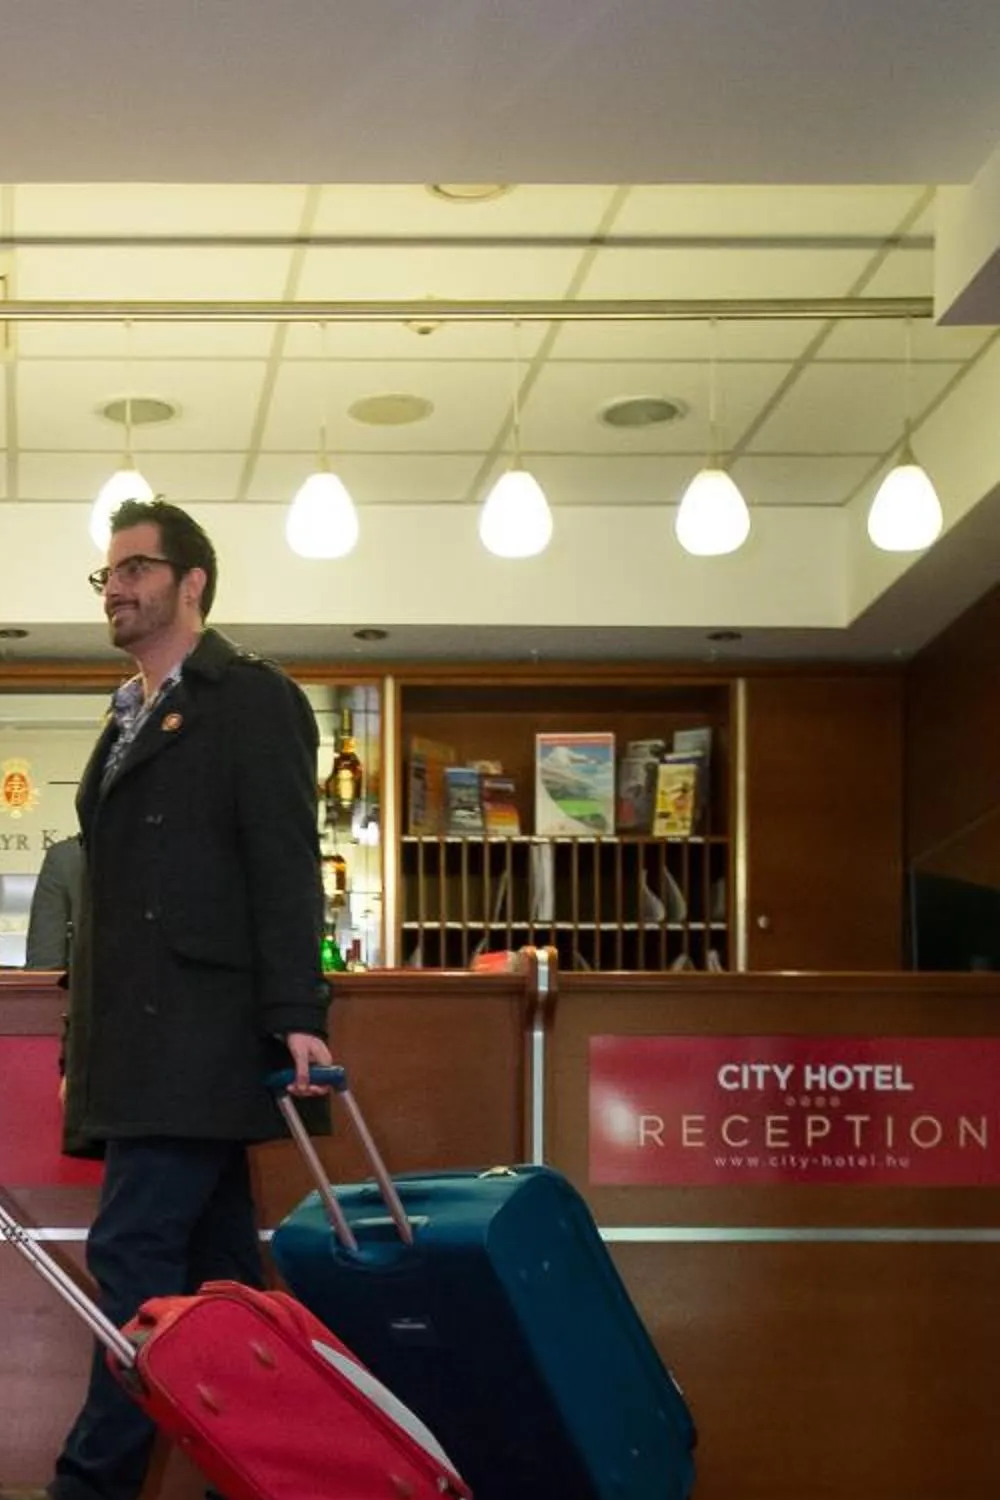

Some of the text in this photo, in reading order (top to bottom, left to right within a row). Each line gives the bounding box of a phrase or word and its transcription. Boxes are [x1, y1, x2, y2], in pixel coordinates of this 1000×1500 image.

[717, 1065, 914, 1091] CITY HOTEL
[636, 1114, 990, 1150] RECEPTION
[714, 1153, 911, 1169] www.city-hotel.hu
